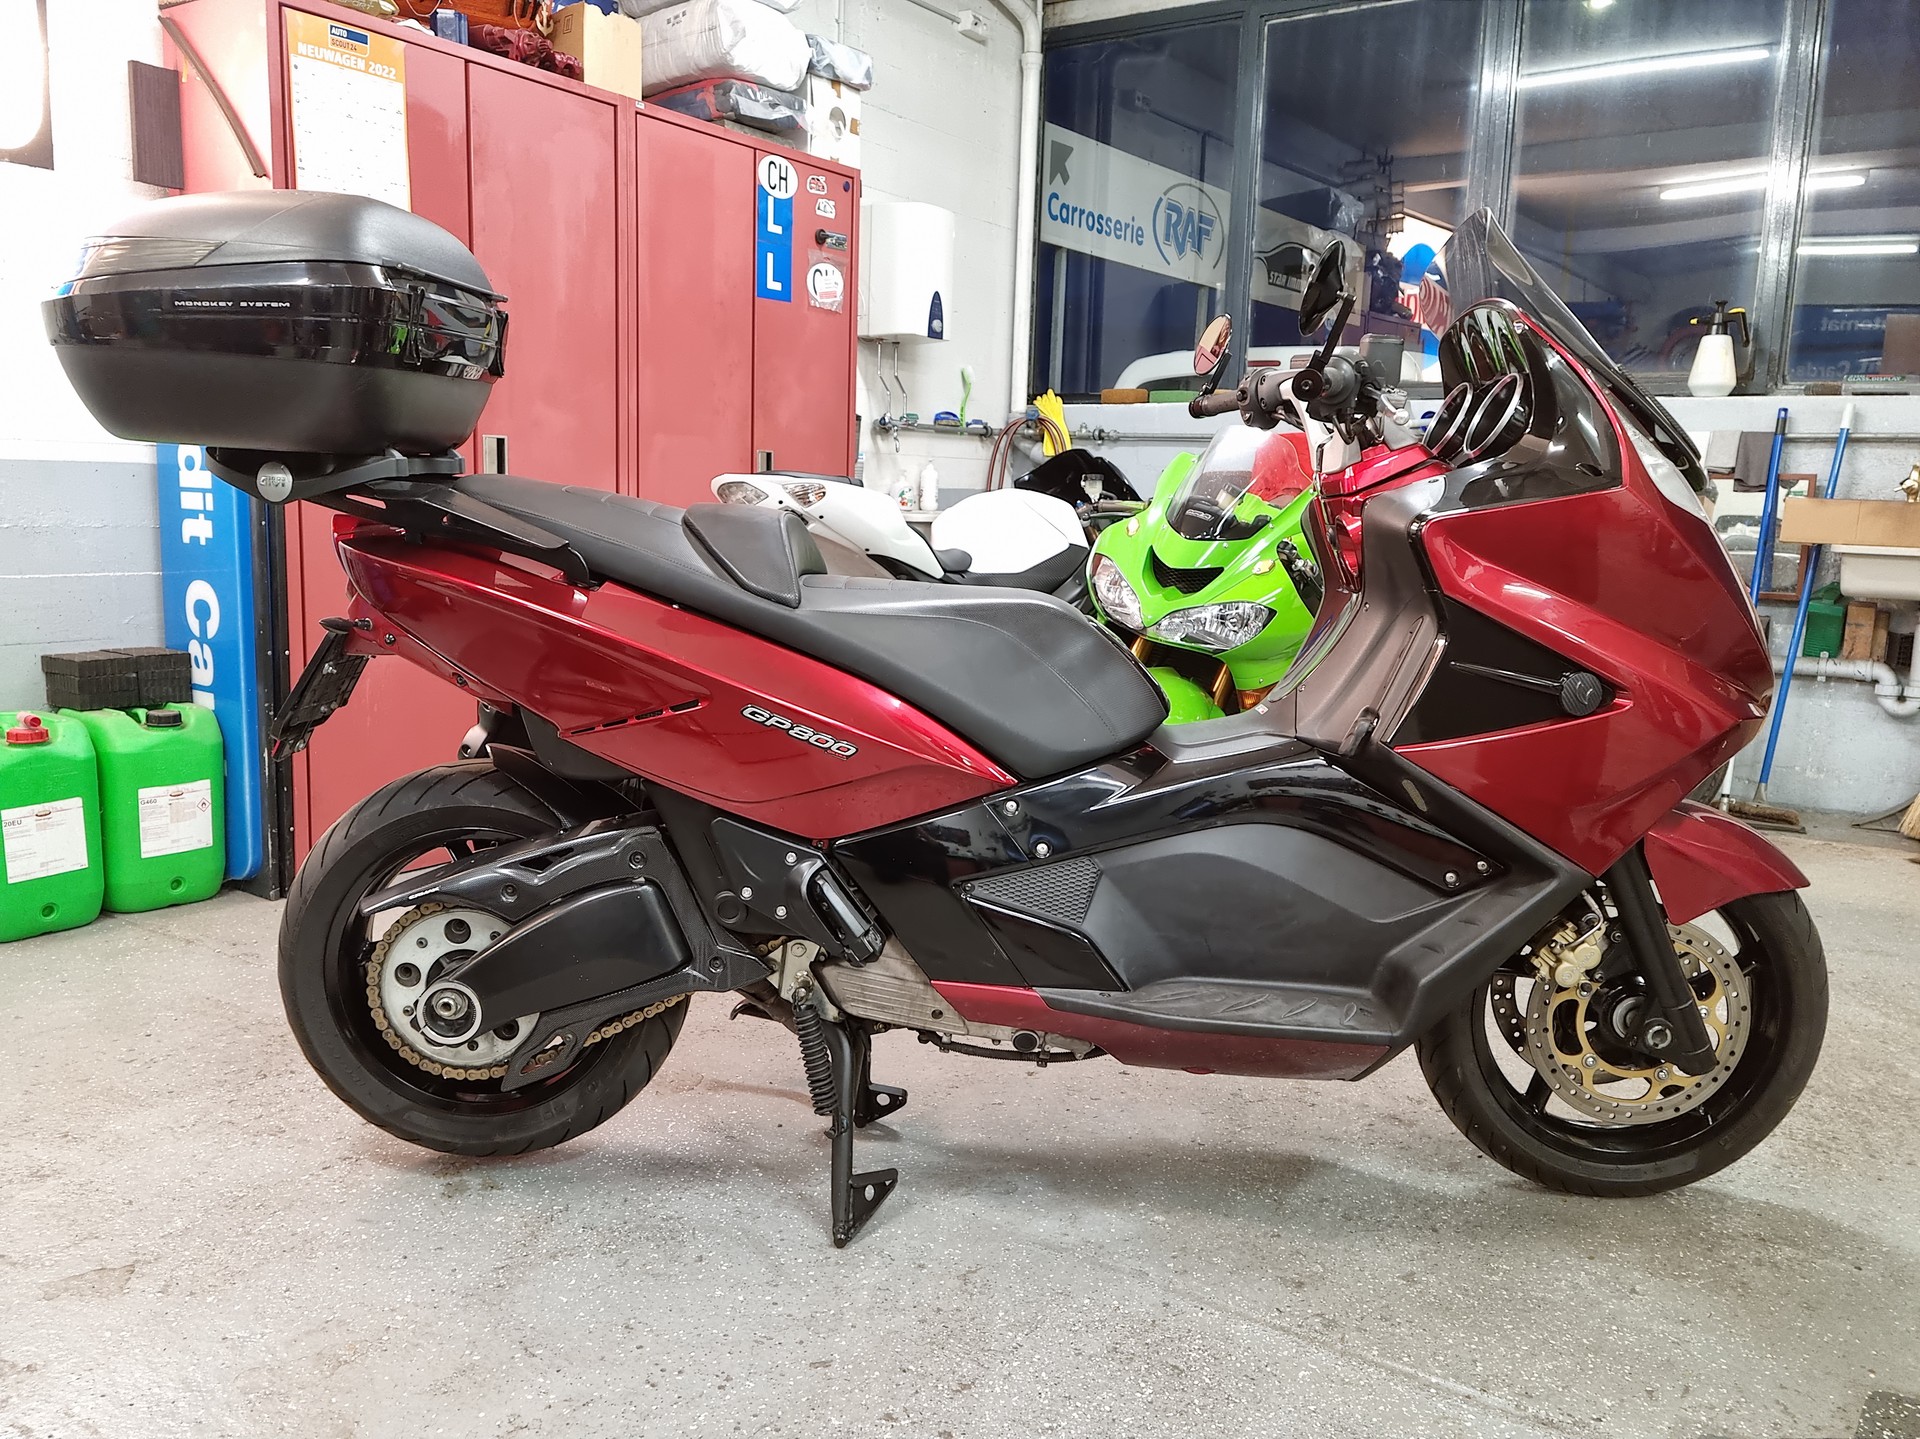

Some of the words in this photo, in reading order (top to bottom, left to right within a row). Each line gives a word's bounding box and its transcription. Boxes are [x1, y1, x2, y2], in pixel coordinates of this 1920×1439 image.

[331, 26, 348, 37] AUTO
[297, 41, 366, 71] NEUWAGEN
[368, 61, 397, 79] 2022
[767, 160, 788, 194] CH
[767, 195, 783, 235] L
[1047, 191, 1145, 246] Carrosserie
[1163, 197, 1217, 261] RAF
[766, 252, 782, 292] L
[177, 444, 214, 546] dit
[741, 704, 859, 757] GP800
[3, 819, 23, 828] 20EU
